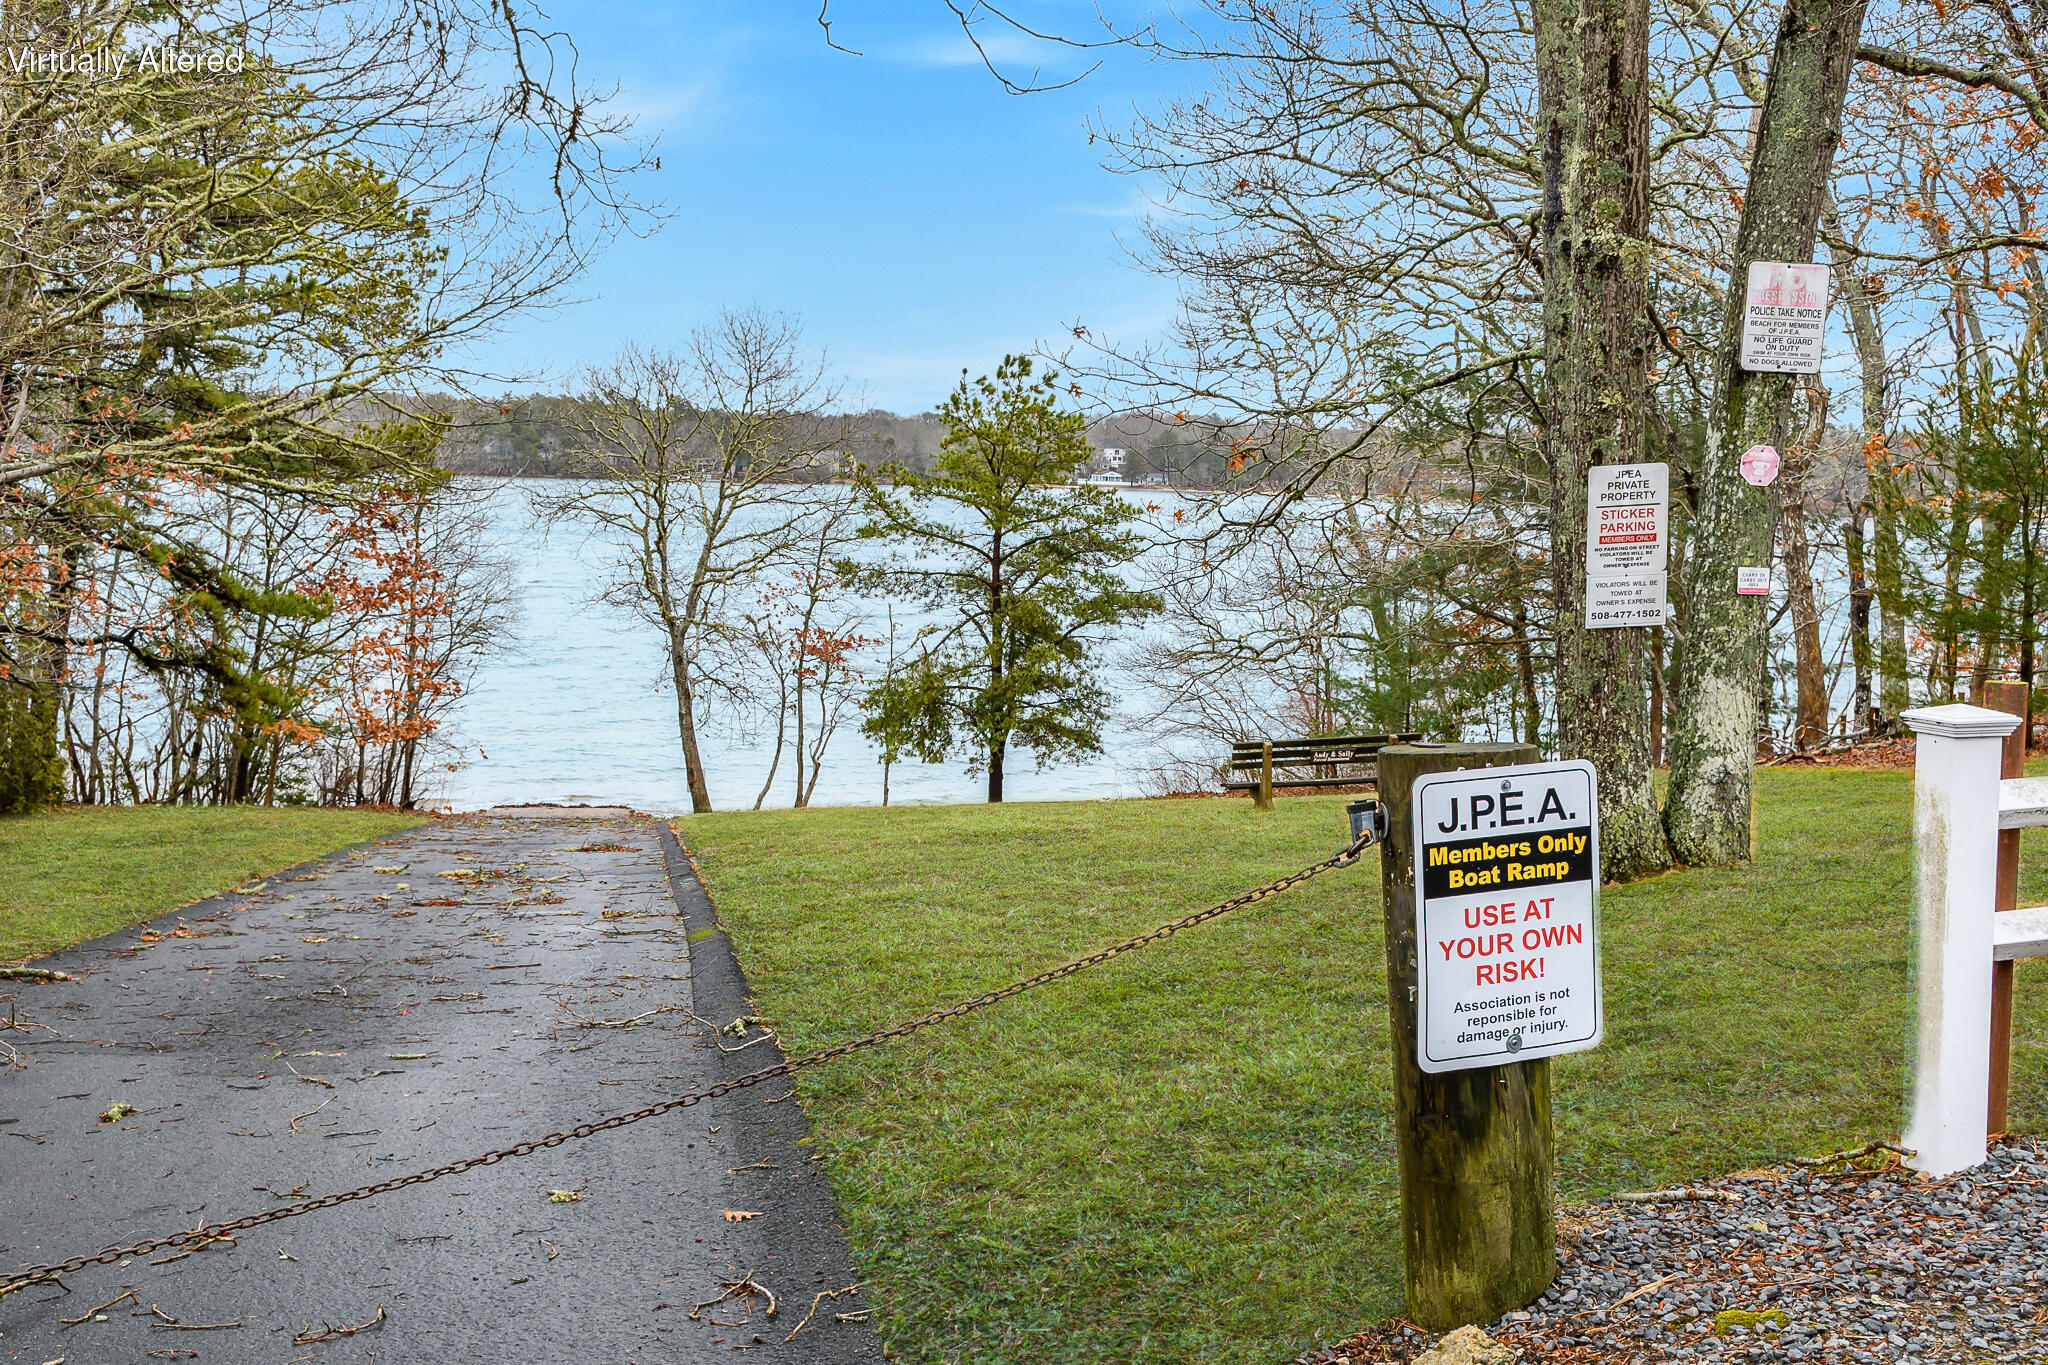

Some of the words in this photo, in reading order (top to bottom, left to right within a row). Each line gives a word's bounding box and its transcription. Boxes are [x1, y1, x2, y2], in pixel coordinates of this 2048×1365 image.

[1750, 306, 1775, 316] POLICE
[1778, 307, 1795, 317] TAKE
[1797, 308, 1822, 318] NOTICE
[1786, 338, 1813, 346] GUARD
[1781, 360, 1813, 368] ALLOWED
[1615, 469, 1642, 479] JPEA
[1607, 480, 1650, 490] PRIVATE
[1600, 490, 1656, 502] PROPERTY
[1601, 507, 1655, 520] STICKER
[1600, 521, 1656, 534] PARKING
[1601, 535, 1635, 544] MEMBERS
[1595, 581, 1630, 589] VIOLATORS
[1627, 597, 1657, 605] EXPENSE
[1591, 609, 1661, 620] 508-477-1502
[1313, 751, 1329, 759] Andy
[1337, 750, 1354, 758] Sally
[1437, 787, 1576, 834] J.P.E.A.
[1429, 840, 1532, 867] Members
[1537, 832, 1587, 855] Only
[1449, 866, 1501, 889] Boat
[1507, 860, 1570, 882] Ramp
[1464, 902, 1516, 929] USE
[1523, 897, 1555, 922] AT
[1438, 932, 1514, 961] YOUR
[1522, 923, 1582, 950] OWN
[1476, 957, 1545, 986] RISK!
[1453, 993, 1531, 1013] Association
[1535, 991, 1546, 1003] is
[1550, 987, 1570, 1000] not
[1467, 1008, 1536, 1027] reponsible
[1539, 1005, 1558, 1017] for
[1457, 1027, 1510, 1043] damage
[1513, 1026, 1527, 1035] or
[1530, 1019, 1568, 1035] injury.
